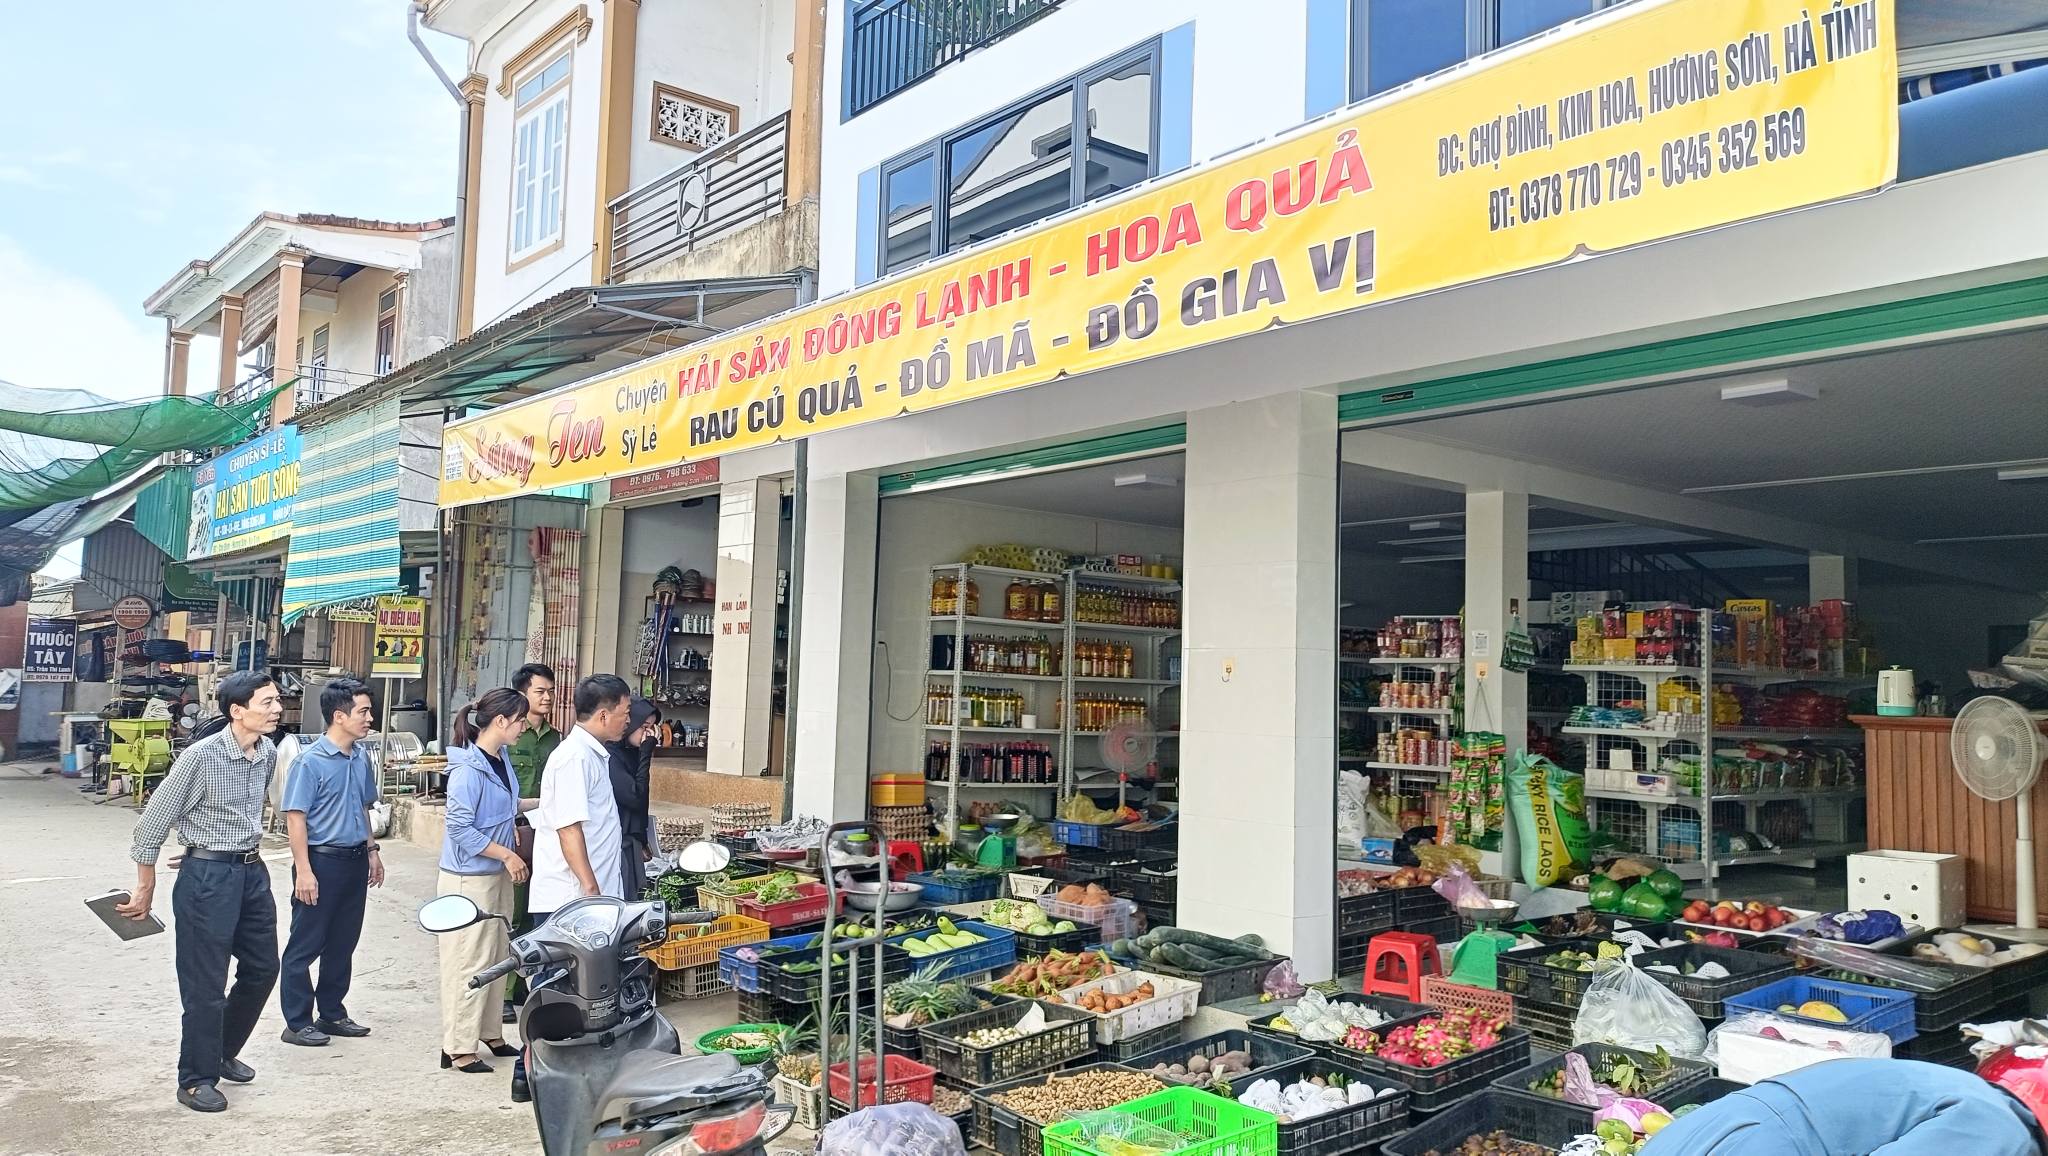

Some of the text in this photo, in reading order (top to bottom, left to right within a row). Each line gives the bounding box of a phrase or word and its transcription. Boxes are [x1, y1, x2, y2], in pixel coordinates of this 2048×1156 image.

[1438, 0, 1878, 177] ĐC: CHỢ ĐÌNH, KIM HOA, HƯƠNG SƠN, HÀ TĨNH
[1489, 106, 1807, 232] ĐT: 0378 770 729 - 0345 352 569
[615, 129, 1373, 416] Chuyên HẢI SẢN ĐÔNG LẠNH - HOA QUẢ
[641, 423, 657, 452] Lẻ
[690, 407, 740, 447] RAU
[747, 386, 785, 433] CỦ
[798, 363, 862, 424] QUẢ
[874, 383, 888, 393] -
[899, 337, 952, 398] ĐỒ
[966, 319, 1036, 381] MÃ
[1052, 335, 1069, 347] -
[1086, 277, 1159, 351] ĐỒ
[1180, 258, 1286, 327] GIA
[1308, 229, 1375, 295] VỊ
[28, 628, 74, 647] THUỐC
[33, 648, 66, 665] TÂY
[1534, 804, 1551, 836] RICE
[1540, 841, 1553, 878] LAOS
